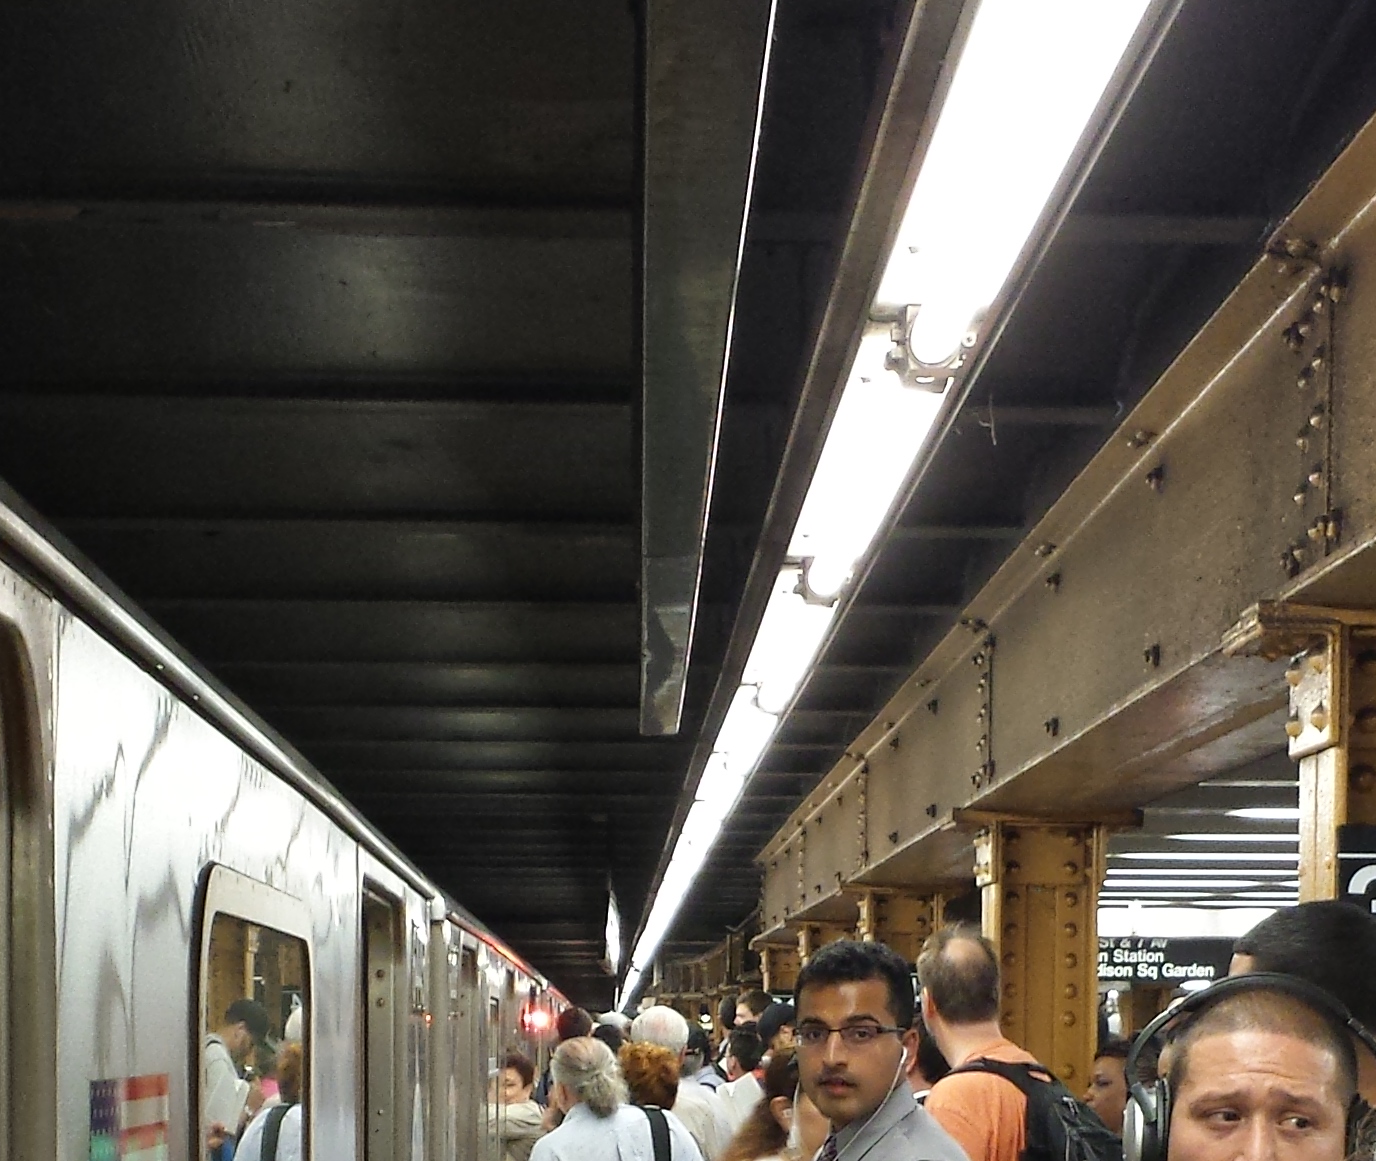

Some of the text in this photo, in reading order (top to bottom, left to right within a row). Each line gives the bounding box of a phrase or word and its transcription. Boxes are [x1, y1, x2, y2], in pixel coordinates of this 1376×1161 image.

[1113, 948, 1164, 963] Station
[1137, 962, 1158, 980] Sq
[1161, 962, 1215, 978] Garden
